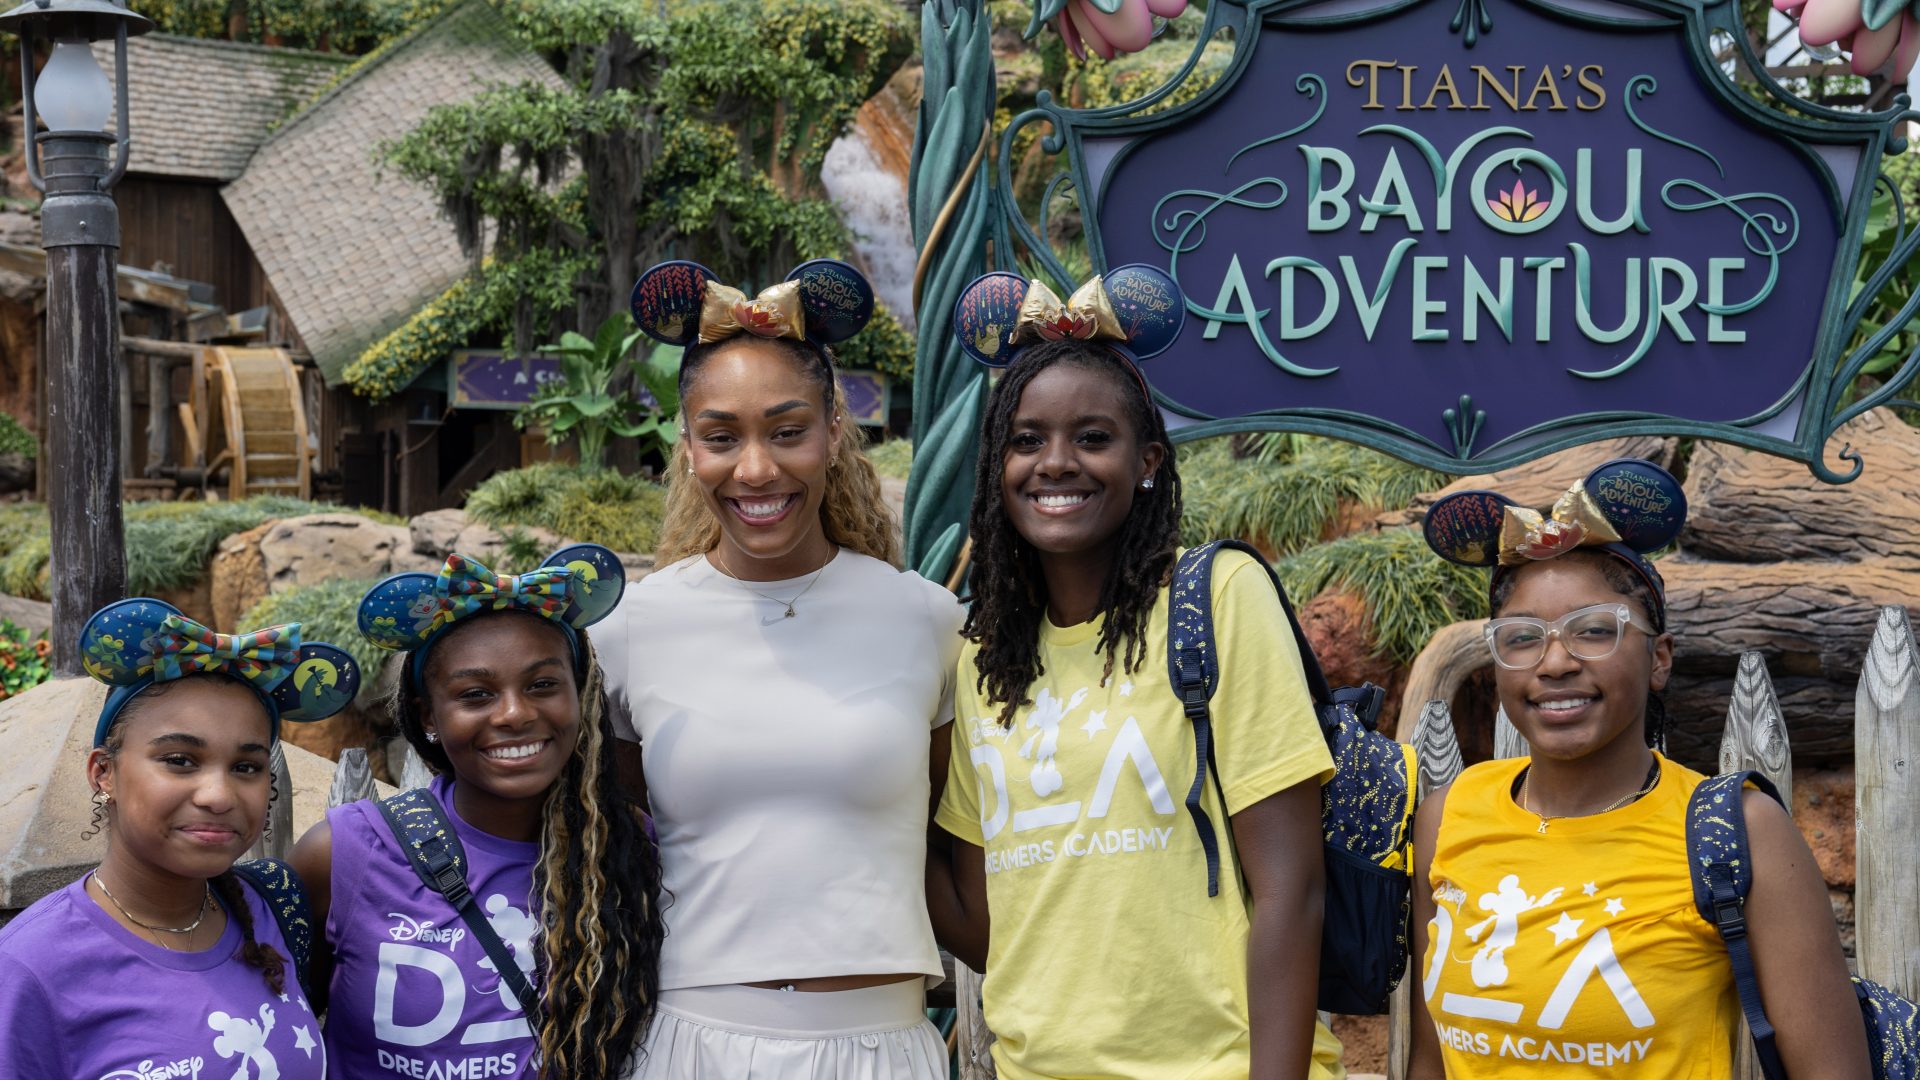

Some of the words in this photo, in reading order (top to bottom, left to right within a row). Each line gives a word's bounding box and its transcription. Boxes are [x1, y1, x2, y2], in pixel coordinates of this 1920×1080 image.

[1347, 59, 1606, 111] TIANA'S
[1298, 124, 1651, 234] BAYOU
[802, 280, 860, 310] ADVENTURE
[817, 273, 852, 298] BAYOU
[1112, 285, 1169, 312] ADVENTURE
[1126, 277, 1161, 298] BAYOU
[1203, 237, 1747, 378] ADVENTURE
[1599, 486, 1668, 513] ADVENTURE
[1615, 478, 1655, 500] BAYOU
[377, 1048, 517, 1080] DREAMERS
[1499, 1034, 1654, 1066] ACADEMY
